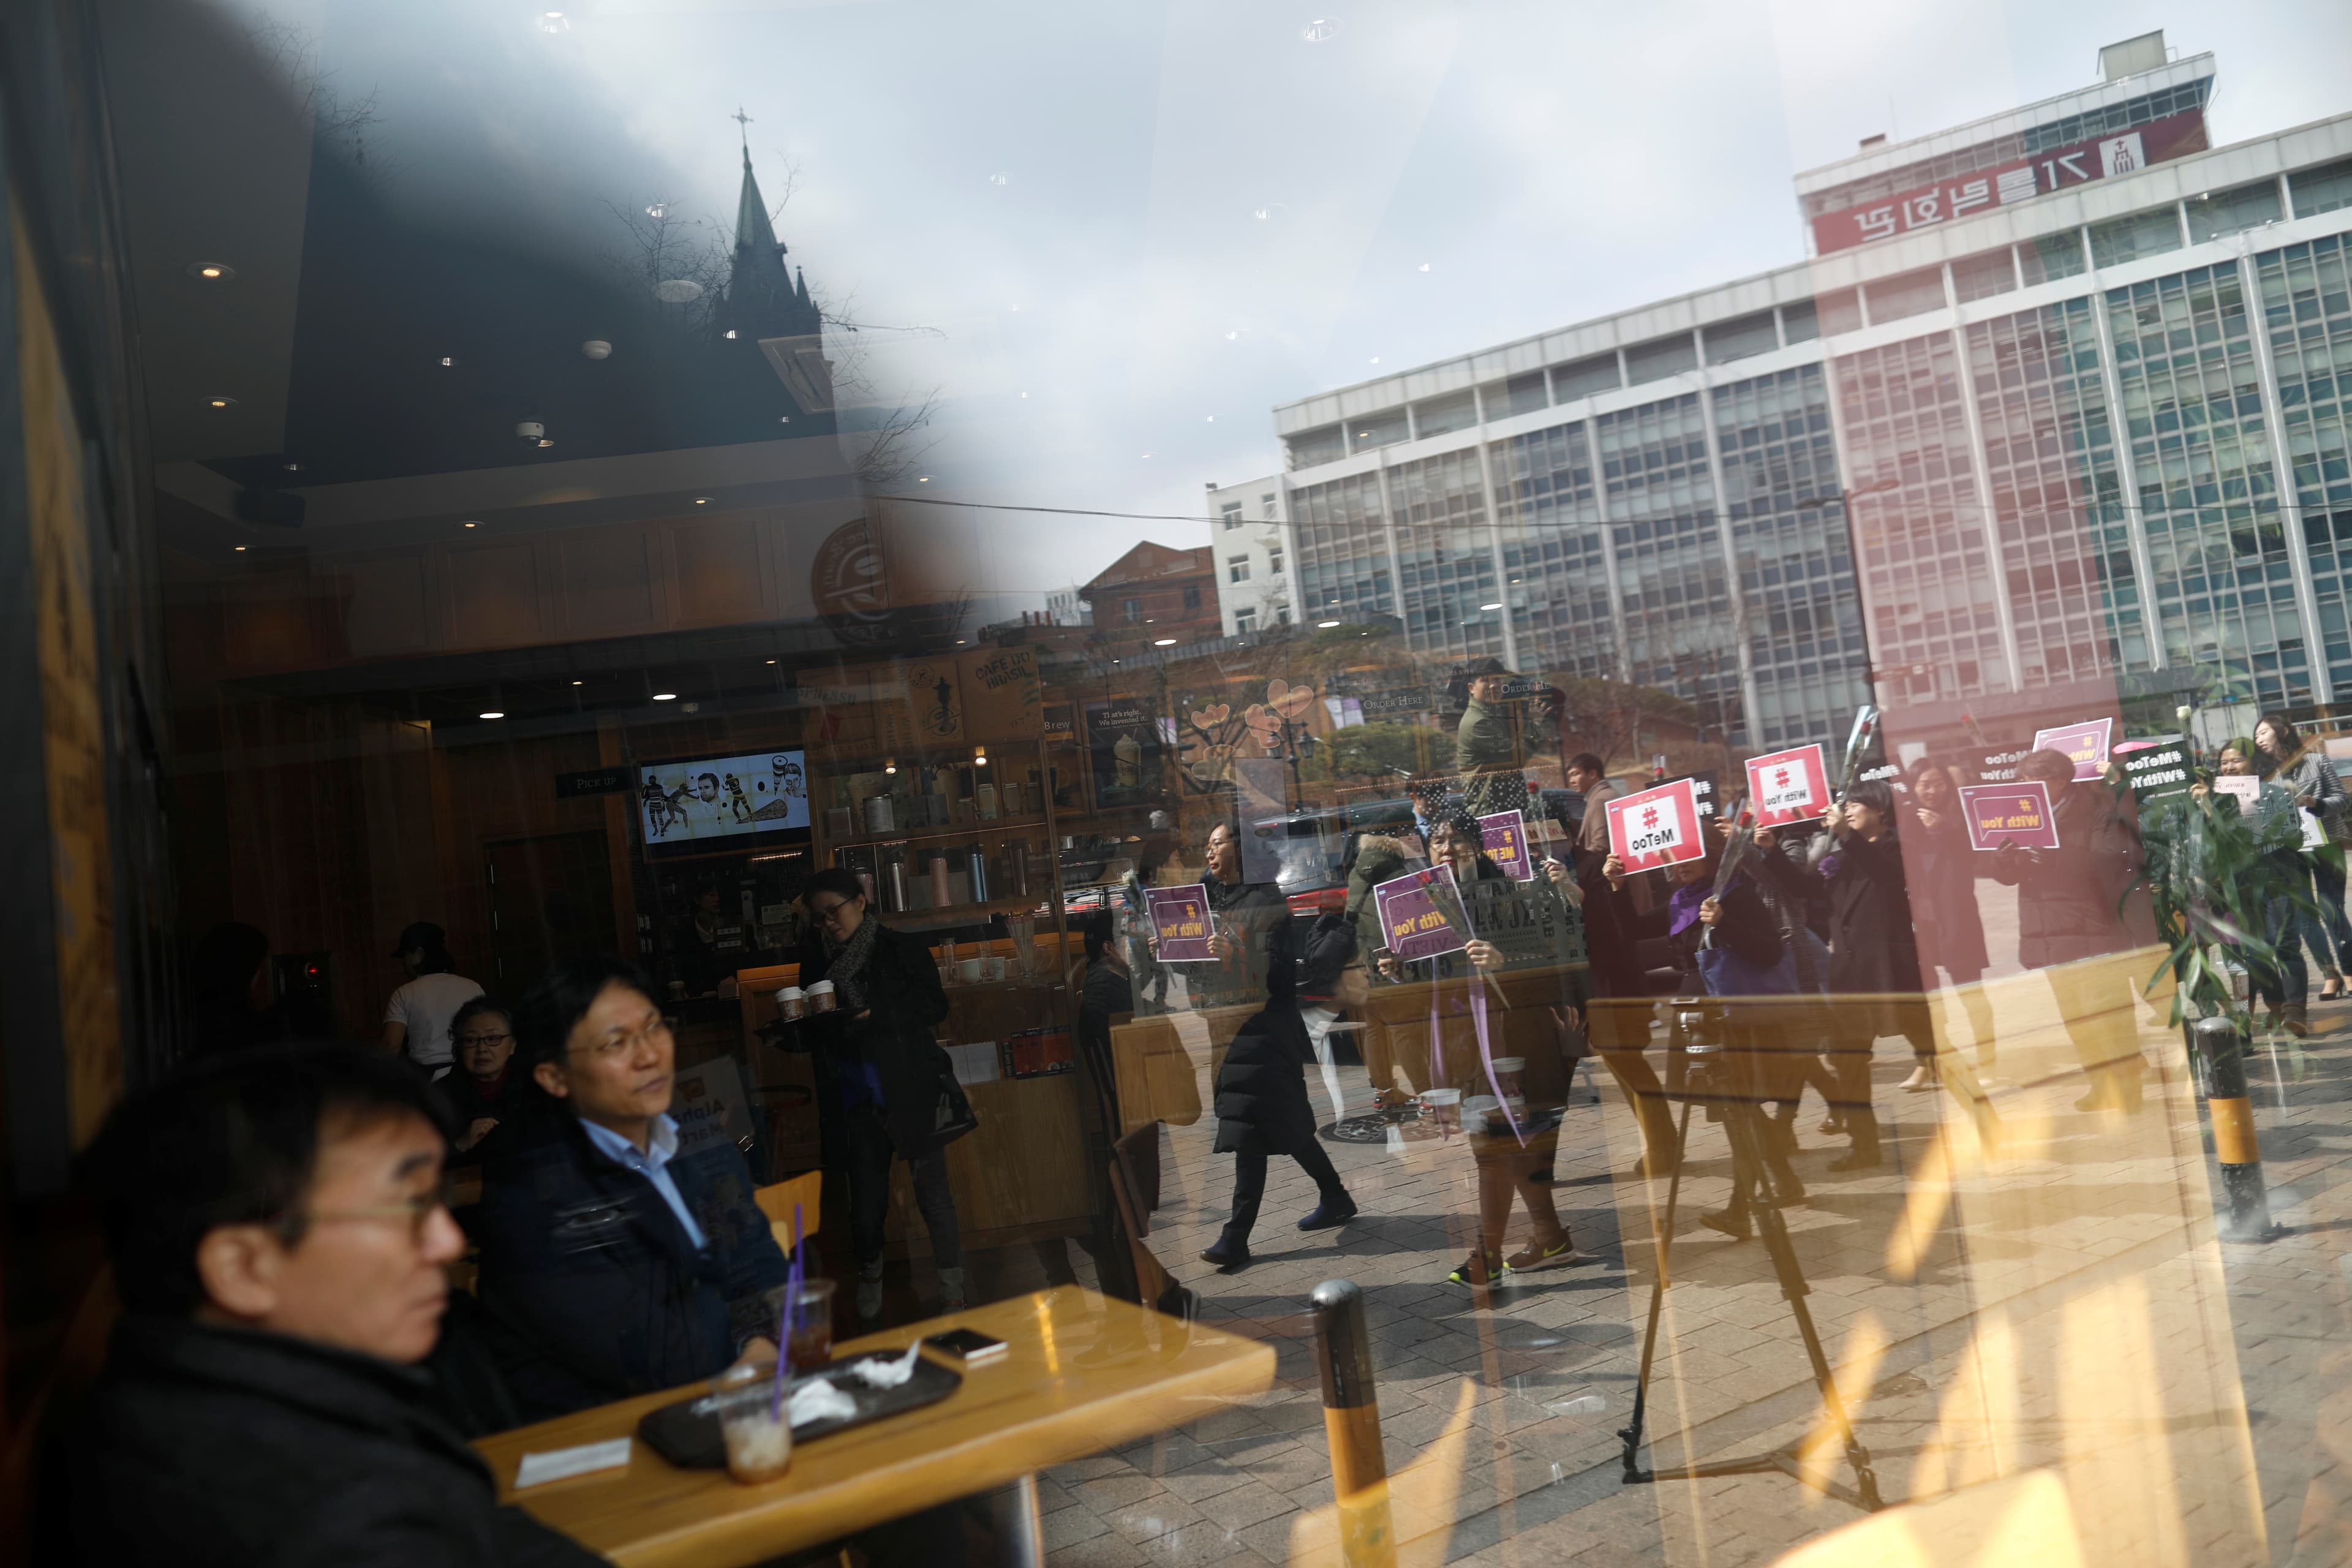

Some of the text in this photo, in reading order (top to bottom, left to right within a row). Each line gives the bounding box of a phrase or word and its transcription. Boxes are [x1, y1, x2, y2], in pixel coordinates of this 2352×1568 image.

[975, 657, 1008, 680] CAFE
[1501, 684, 1532, 693] ORDER
[1363, 695, 1423, 710] ORDER HERE
[1124, 708, 1142, 717] right.
[1044, 720, 1071, 731] Brew
[1111, 716, 1139, 725] invented
[576, 778, 601, 789] PICK
